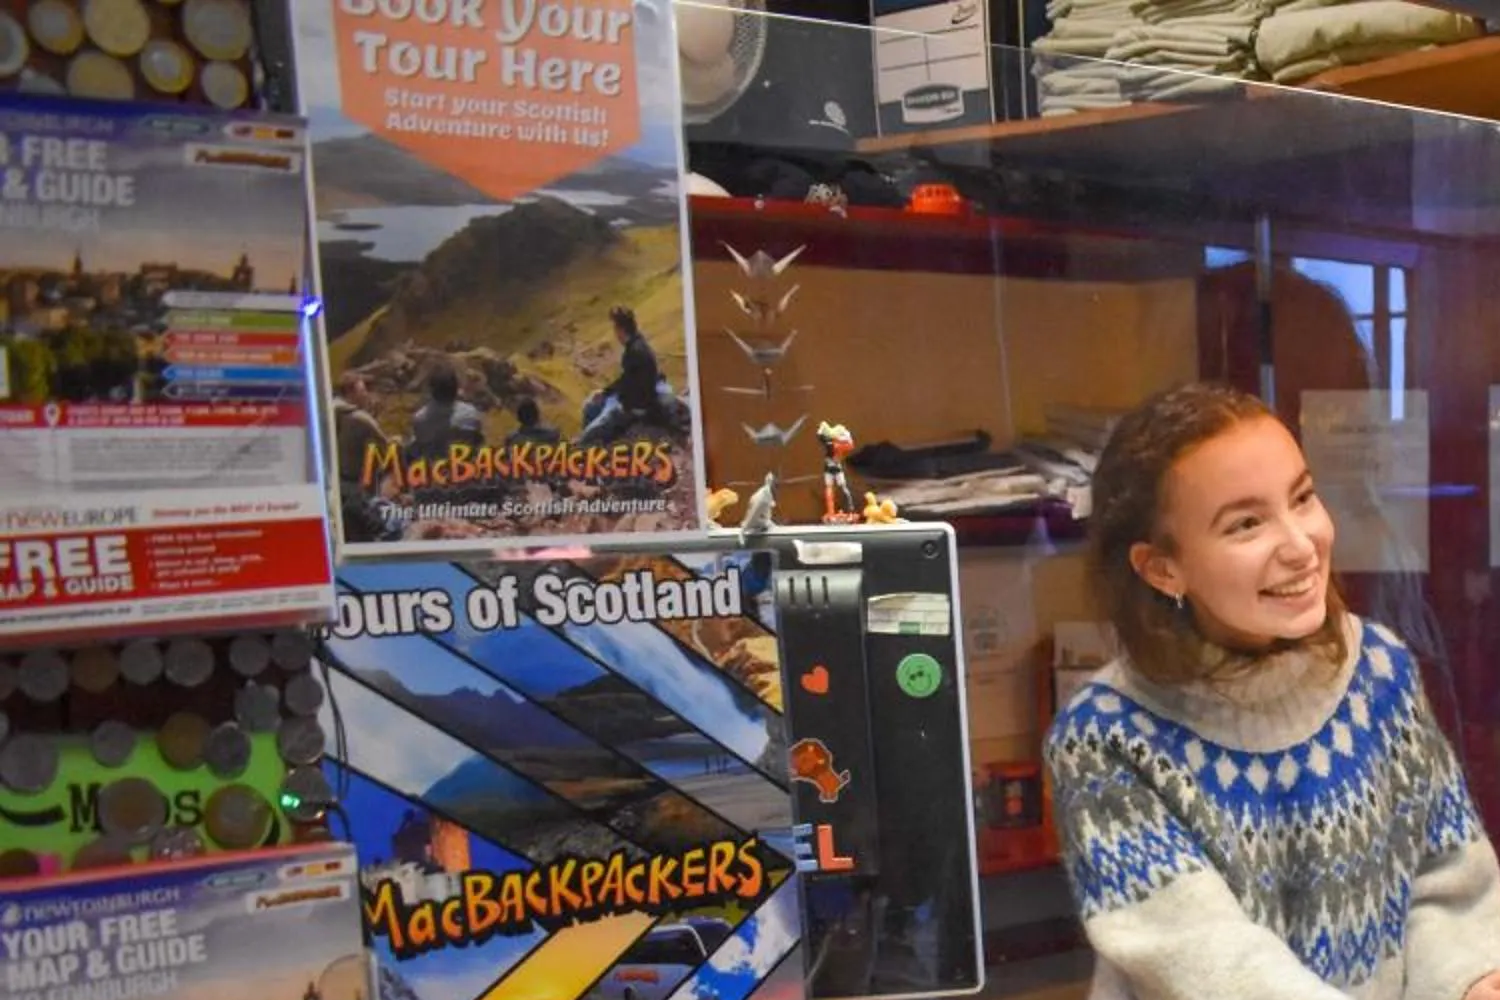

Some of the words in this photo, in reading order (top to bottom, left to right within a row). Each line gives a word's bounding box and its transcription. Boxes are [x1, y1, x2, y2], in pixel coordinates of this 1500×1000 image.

[495, 0, 632, 43] your
[354, 30, 487, 83] Tour
[501, 48, 622, 95] Here
[384, 87, 446, 112] Start
[451, 95, 507, 118] your
[512, 99, 607, 126] Scottish
[385, 113, 513, 140] Adventure
[517, 123, 568, 144] with
[22, 136, 107, 170] FREE
[37, 172, 135, 206] GUIDE
[379, 503, 415, 521] The
[418, 501, 498, 520] Ultimate
[502, 498, 575, 517] Scottish
[579, 497, 665, 514] Adventure
[65, 575, 135, 596] GUIDE
[322, 590, 452, 637] ours
[467, 574, 520, 630] of
[534, 567, 742, 627] Scotland
[2, 920, 89, 960] YOUR
[101, 908, 178, 946] FREE
[7, 953, 80, 992] MAP
[87, 949, 111, 980] &
[116, 934, 208, 975] GUIDE
